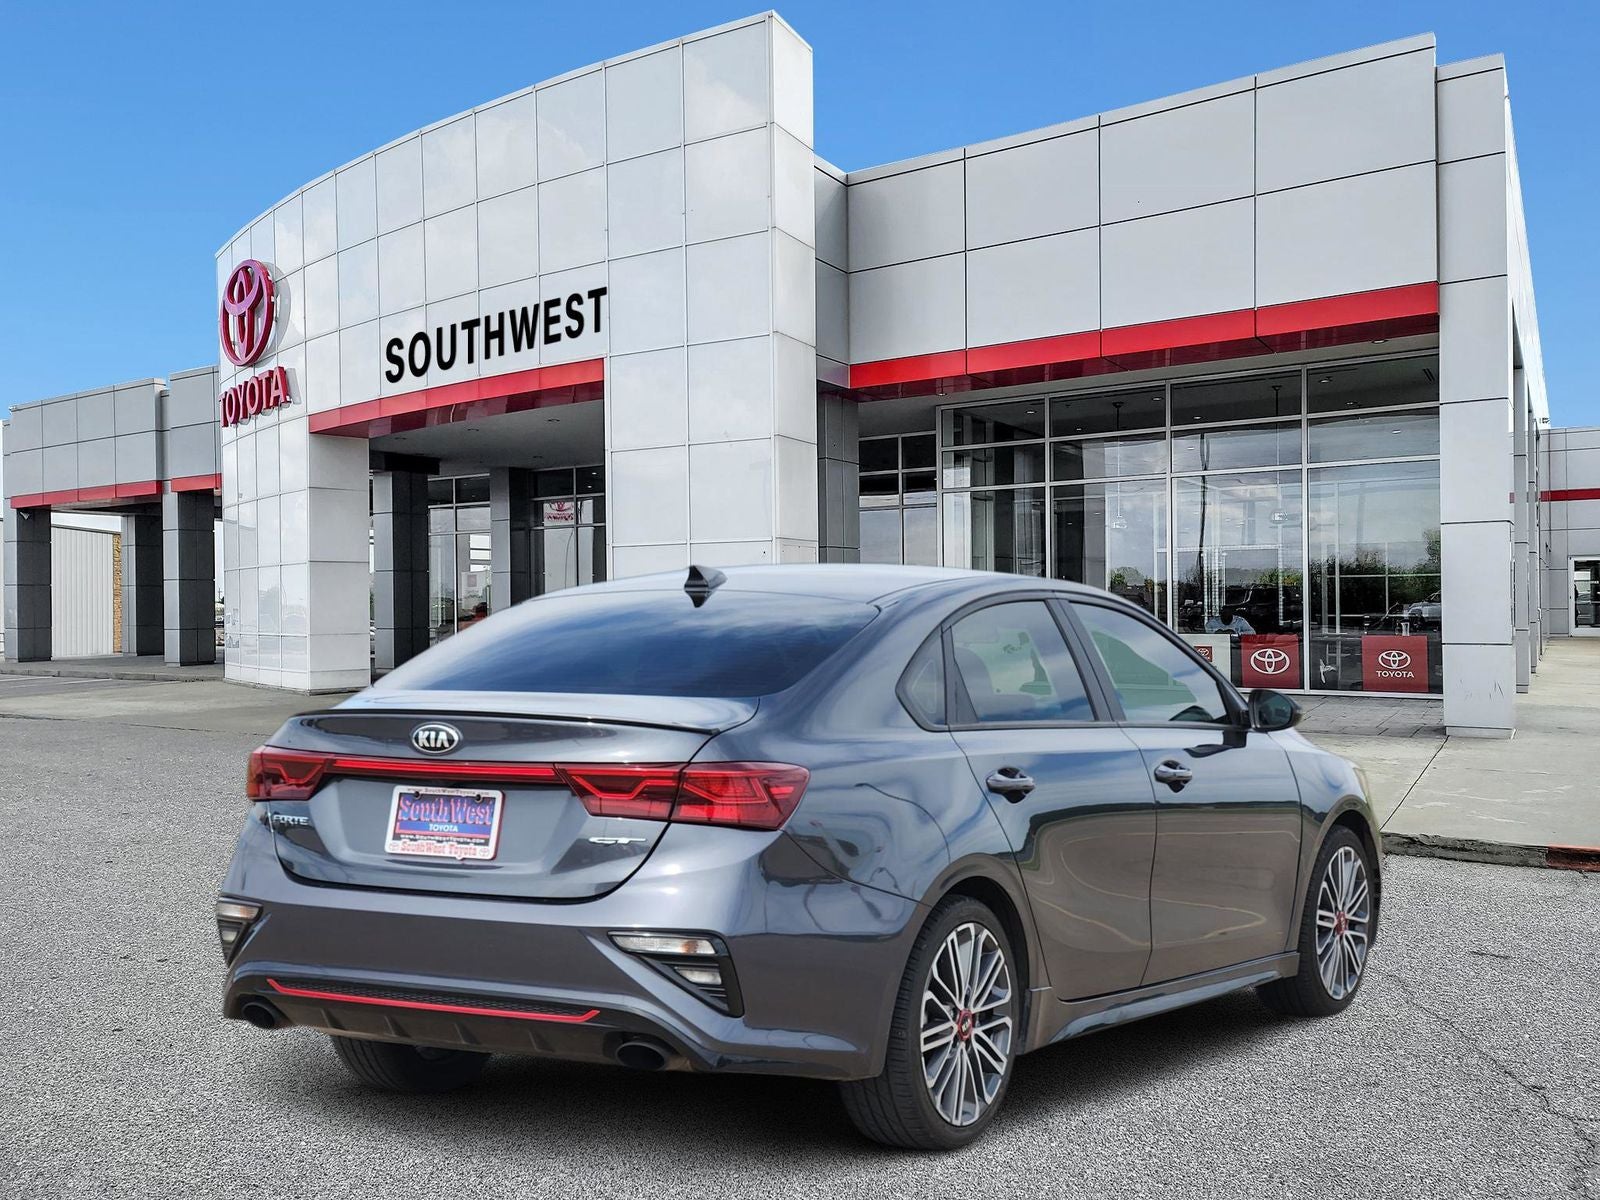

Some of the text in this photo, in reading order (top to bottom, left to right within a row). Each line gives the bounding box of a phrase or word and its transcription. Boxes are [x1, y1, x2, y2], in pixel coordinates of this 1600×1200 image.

[385, 286, 608, 384] SOUTHWEST
[219, 366, 290, 428] TOYOTA
[1376, 670, 1415, 679] TOYOTA
[418, 730, 450, 748] KIA
[273, 814, 310, 826] FORTE
[429, 823, 459, 832] TOYOTA
